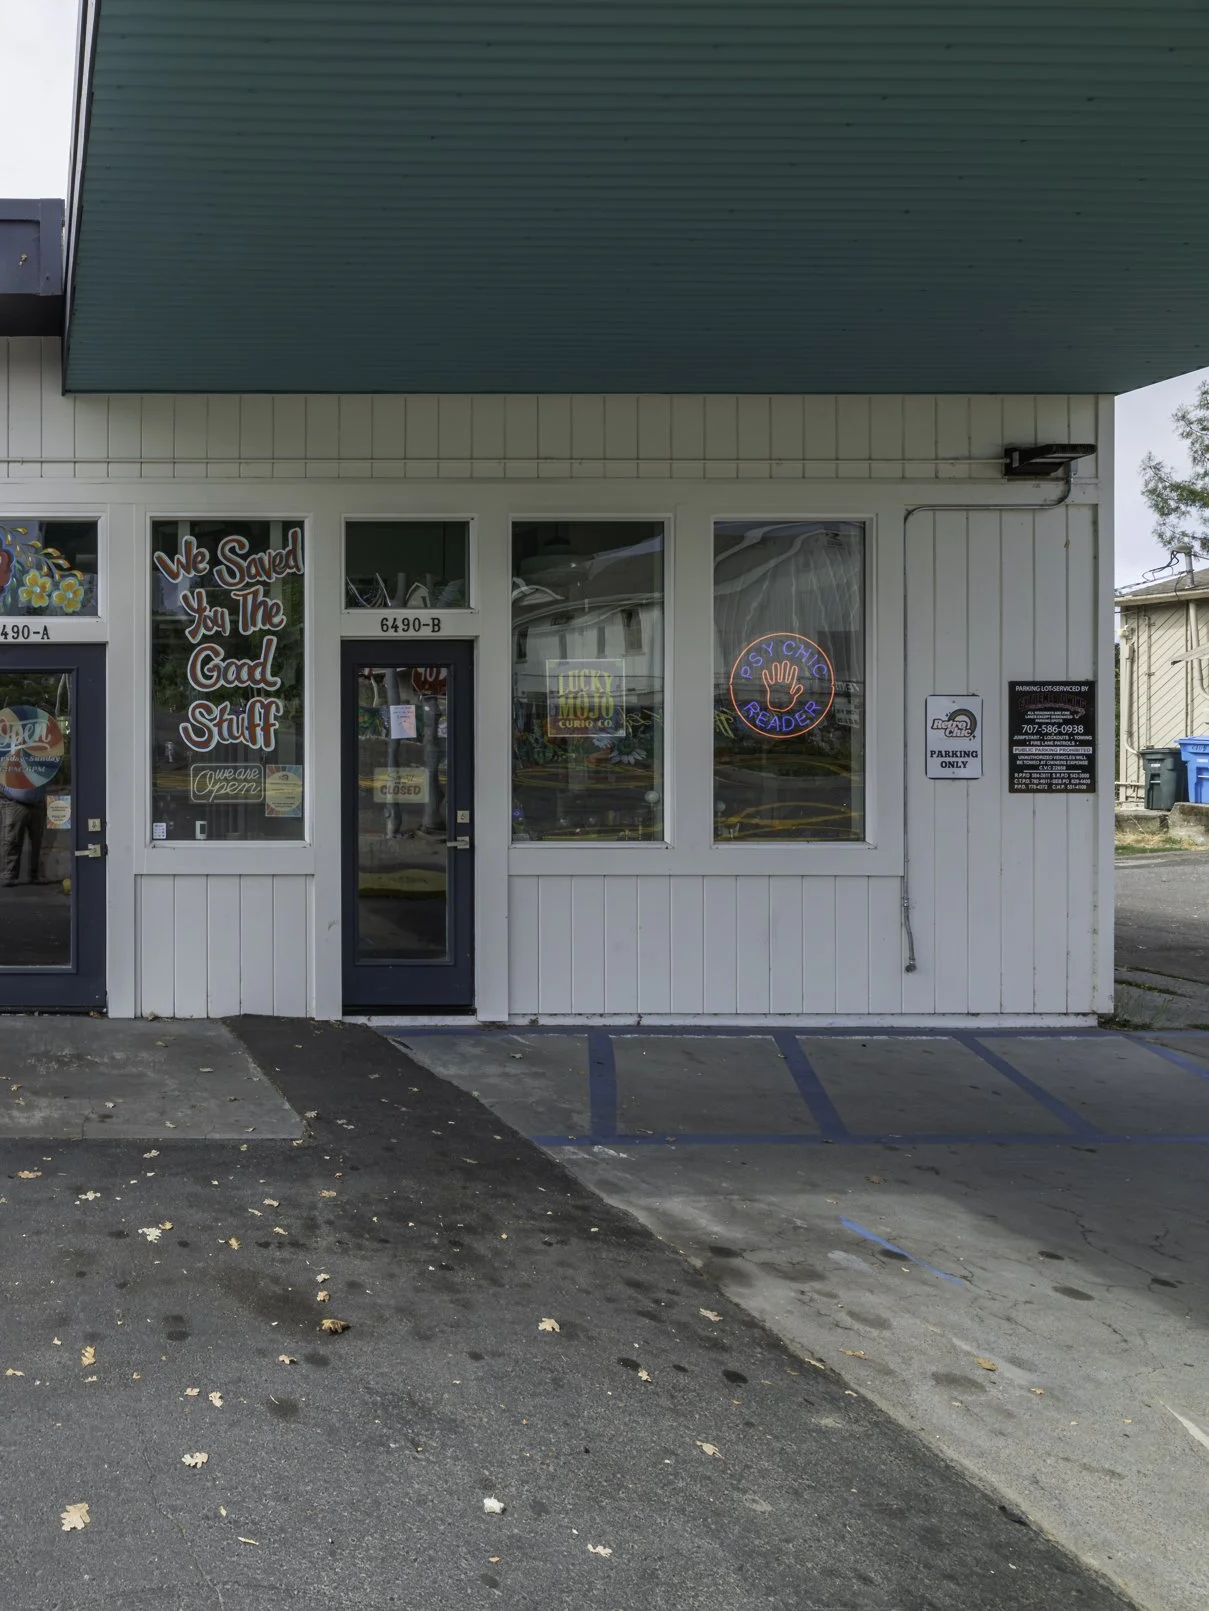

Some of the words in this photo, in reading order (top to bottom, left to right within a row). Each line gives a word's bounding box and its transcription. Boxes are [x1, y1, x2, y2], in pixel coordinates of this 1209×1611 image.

[154, 536, 210, 583] We
[213, 528, 305, 589] Saved
[180, 588, 230, 644] You
[231, 585, 287, 635] The
[380, 617, 441, 633] 6490-B
[187, 636, 282, 692] Good
[557, 668, 613, 695] LUCKY
[558, 691, 615, 719] MOJO
[559, 720, 593, 728] CURIO
[743, 700, 821, 732] READER
[931, 719, 969, 729] Retro
[179, 697, 284, 752] Stuff
[945, 728, 973, 737] Chic
[1021, 725, 1084, 733] 707-586-0938
[930, 750, 978, 758] PARKING
[940, 760, 968, 769] ONLY
[215, 768, 235, 780] we
[235, 768, 260, 780] are
[194, 769, 261, 802] Open
[380, 785, 422, 796] CLOSED
